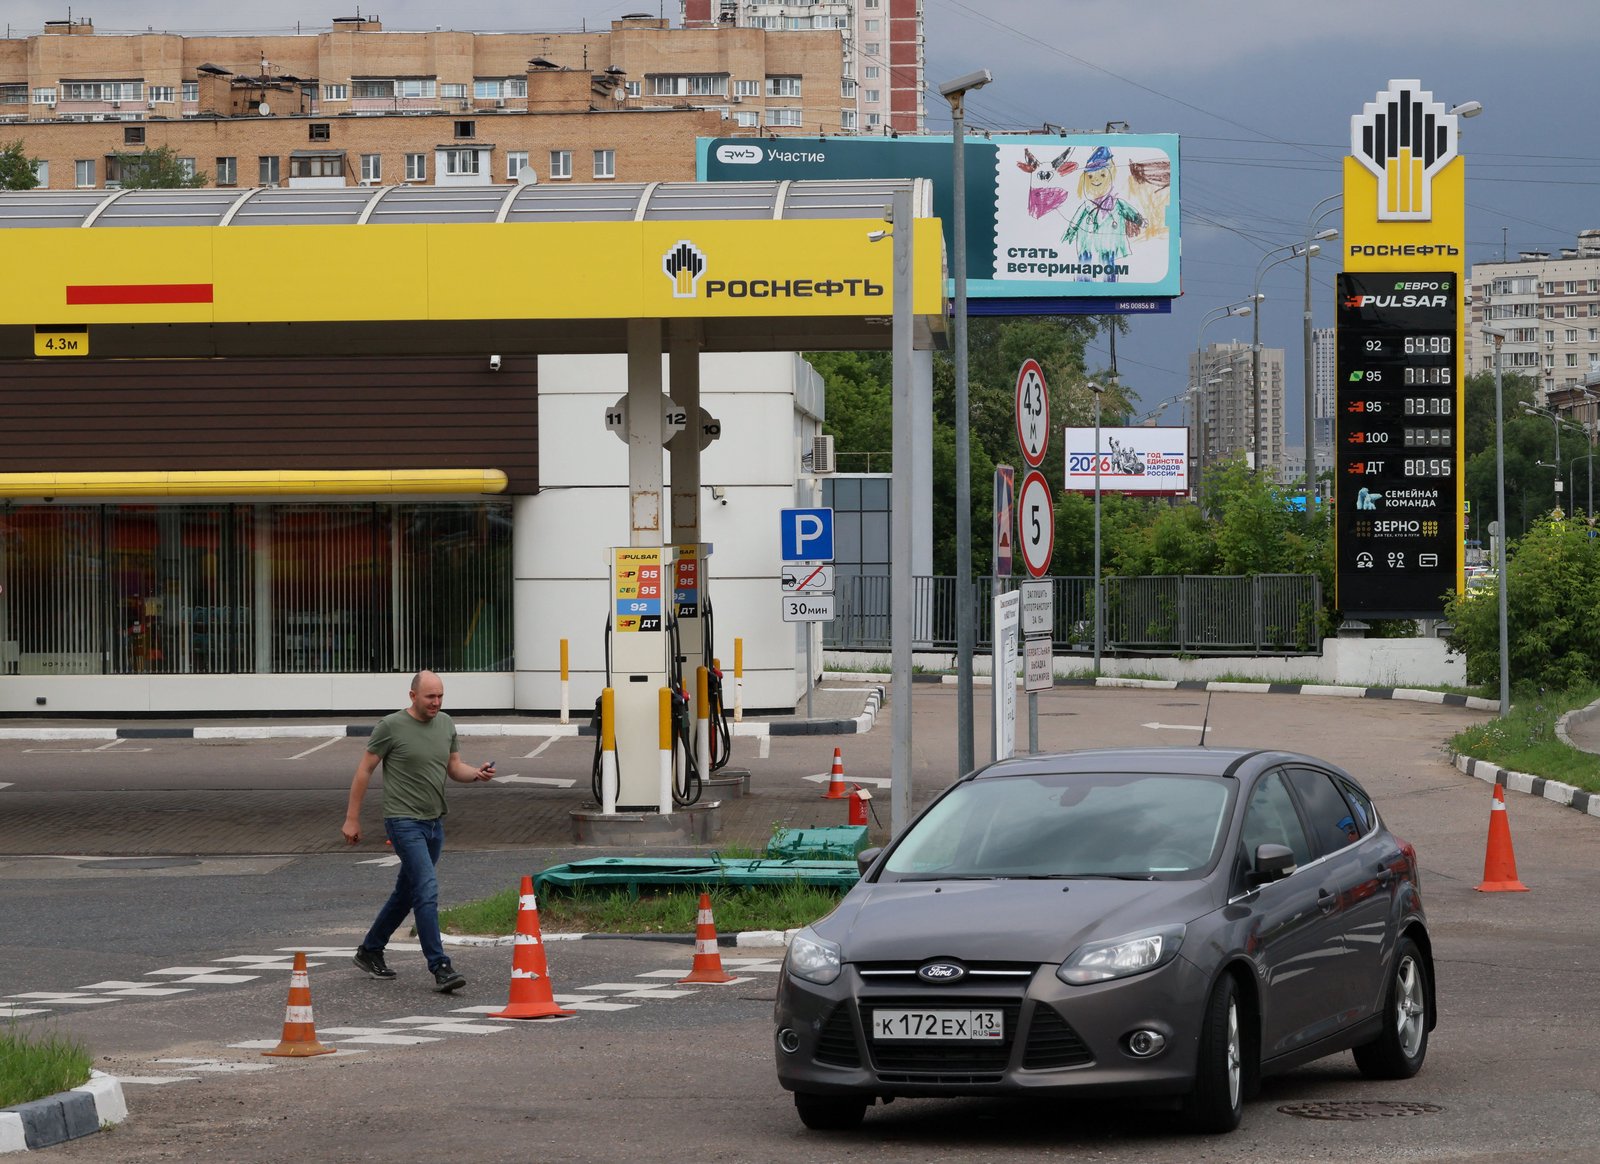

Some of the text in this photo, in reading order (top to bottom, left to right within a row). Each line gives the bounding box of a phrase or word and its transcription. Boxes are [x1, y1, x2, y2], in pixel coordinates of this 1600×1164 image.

[768, 150, 824, 162] Участие
[1008, 247, 1058, 258] стать
[1350, 245, 1458, 256] РОСНЕФТЬ
[1008, 262, 1128, 278] ветеринаром
[706, 279, 884, 298] РОСНЕФТЬ
[1360, 296, 1448, 307] PULSAR
[46, 338, 78, 350] 4.3м
[1366, 337, 1450, 354] 92 64.90
[1366, 368, 1450, 384] 95 71.15
[1366, 398, 1450, 414] 95 73.70
[606, 414, 622, 424] 11
[666, 414, 686, 424] 12
[702, 424, 720, 434] 10
[1366, 432, 1388, 443] 100
[1070, 456, 1110, 472] 2026
[1366, 460, 1450, 476] ДТ 80.55
[1386, 488, 1438, 498] СЕМЕЙНАЯ
[1386, 500, 1436, 508] КОМАНДА
[1032, 506, 1040, 545] 5
[1374, 520, 1420, 532] ЗЕРНО
[641, 570, 658, 578] 95
[630, 603, 648, 611] 92
[790, 603, 828, 615] 30мин
[641, 620, 658, 628] ДТ
[928, 966, 952, 976] Ford
[974, 1014, 994, 1029] 13
